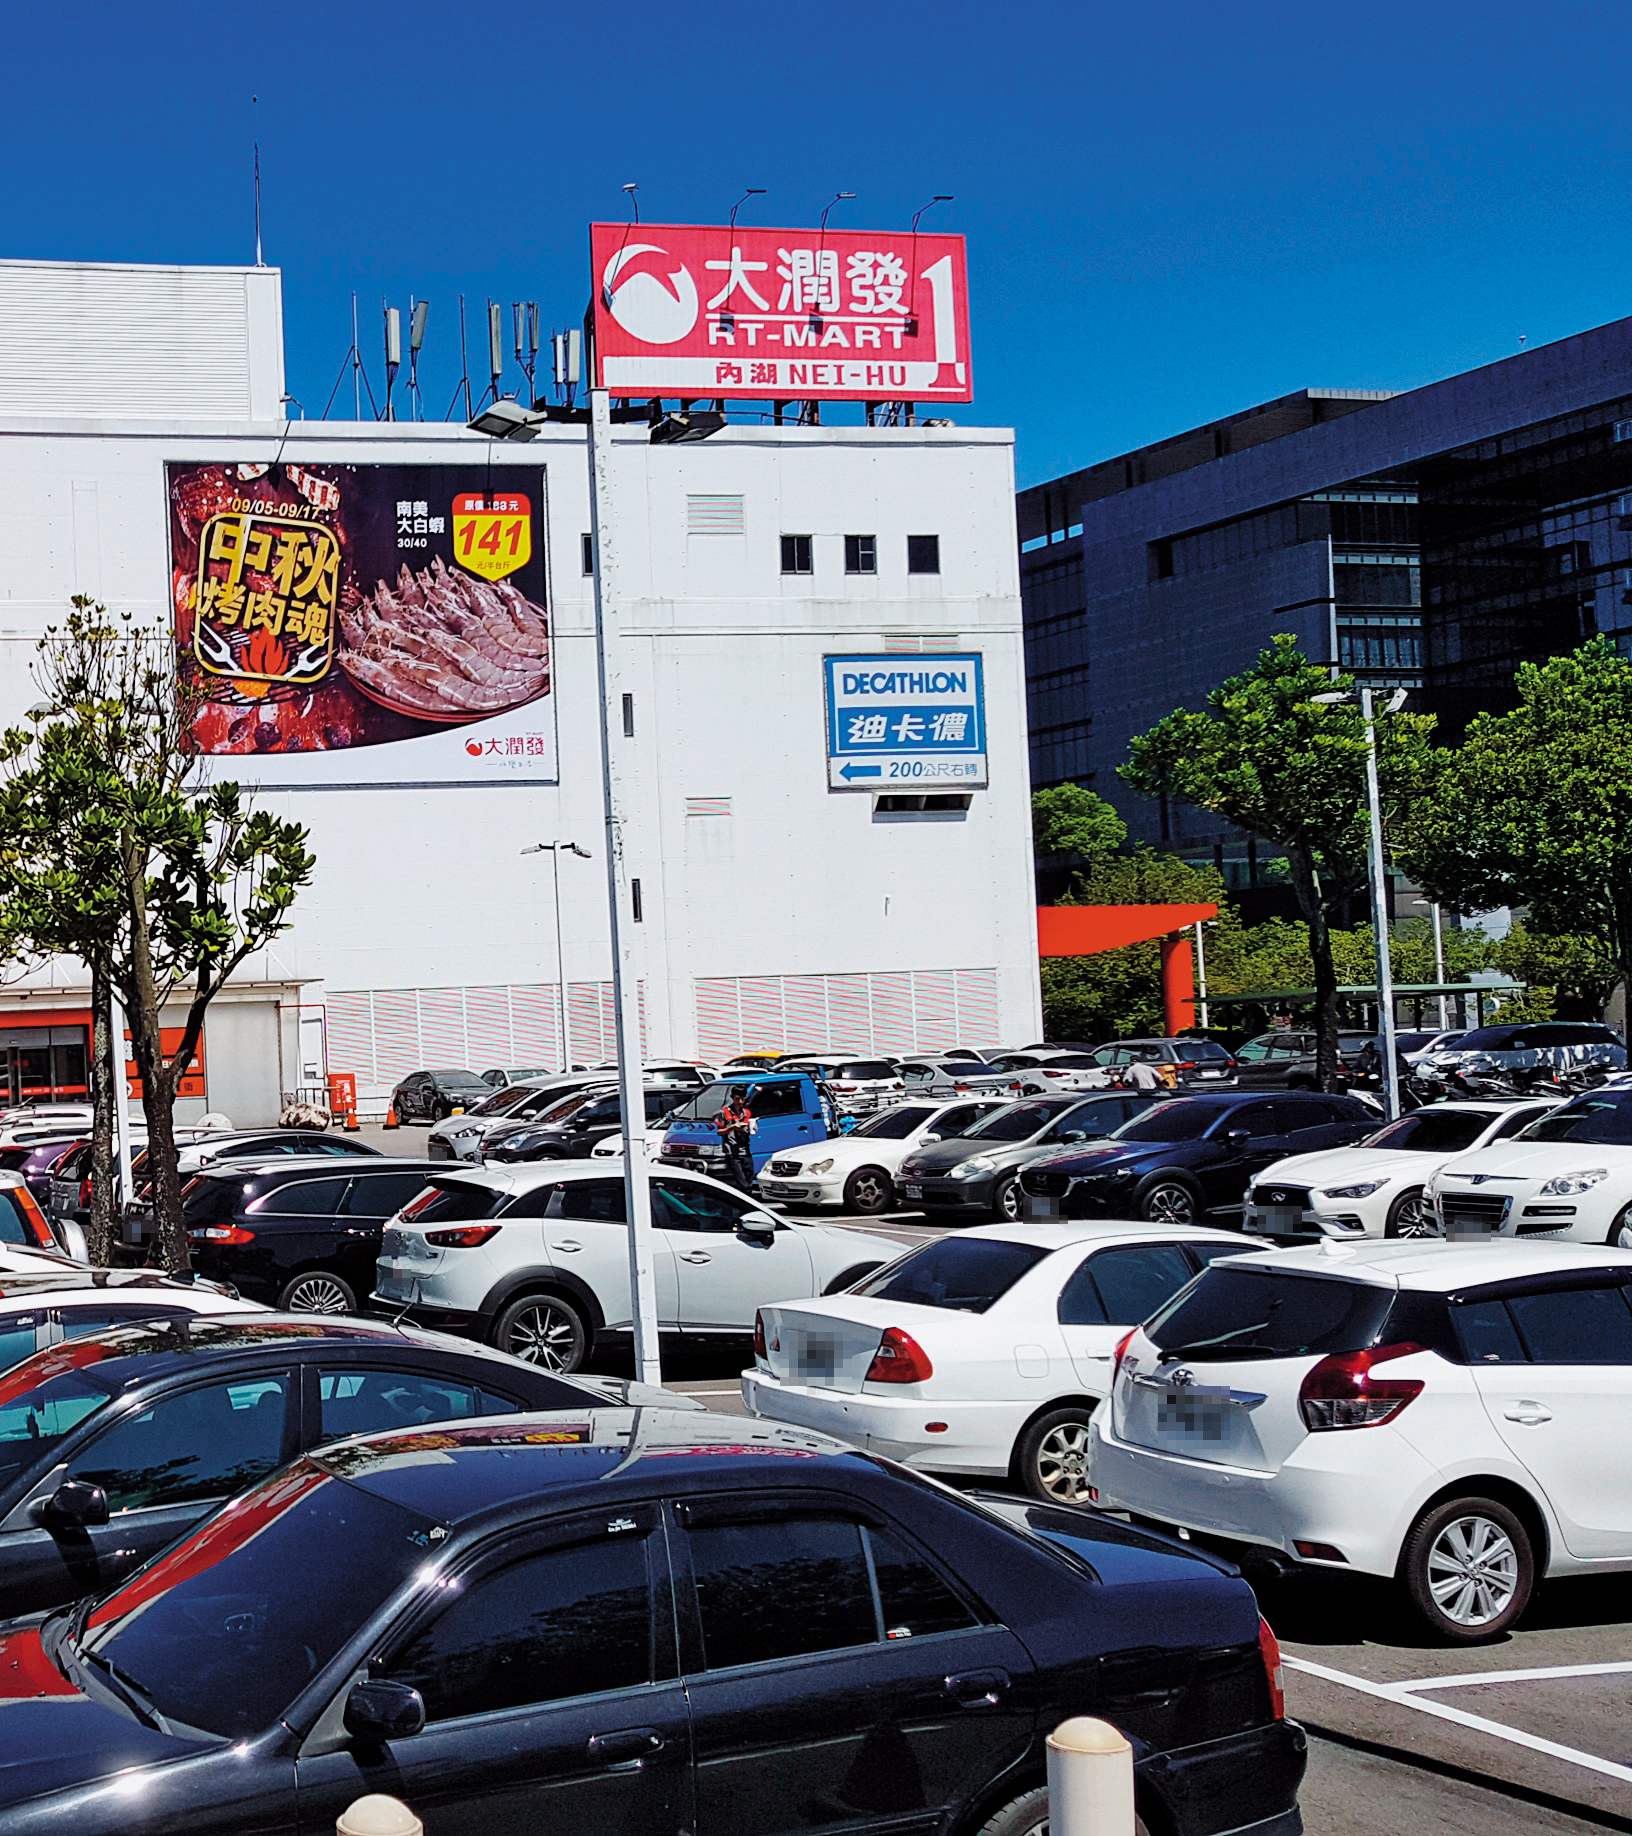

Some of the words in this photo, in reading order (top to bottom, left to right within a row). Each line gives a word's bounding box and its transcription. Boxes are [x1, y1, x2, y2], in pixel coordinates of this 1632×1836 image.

[704, 246, 909, 315] 大潤發
[708, 322, 909, 350] RT-MART
[789, 363, 907, 387] NEI-HU
[231, 497, 321, 520] 09/05-09/17
[396, 500, 429, 517] 南美
[396, 517, 445, 534] 大白蝦
[459, 519, 523, 556] 141
[397, 537, 428, 549] 30/40
[210, 514, 341, 606] 中秋
[201, 575, 329, 648] 烤肉魂
[842, 671, 967, 695] DECATHLON
[847, 712, 969, 744] 迪卡儂
[484, 737, 544, 756] 大潤發
[889, 761, 978, 778] 200公尺右轉
